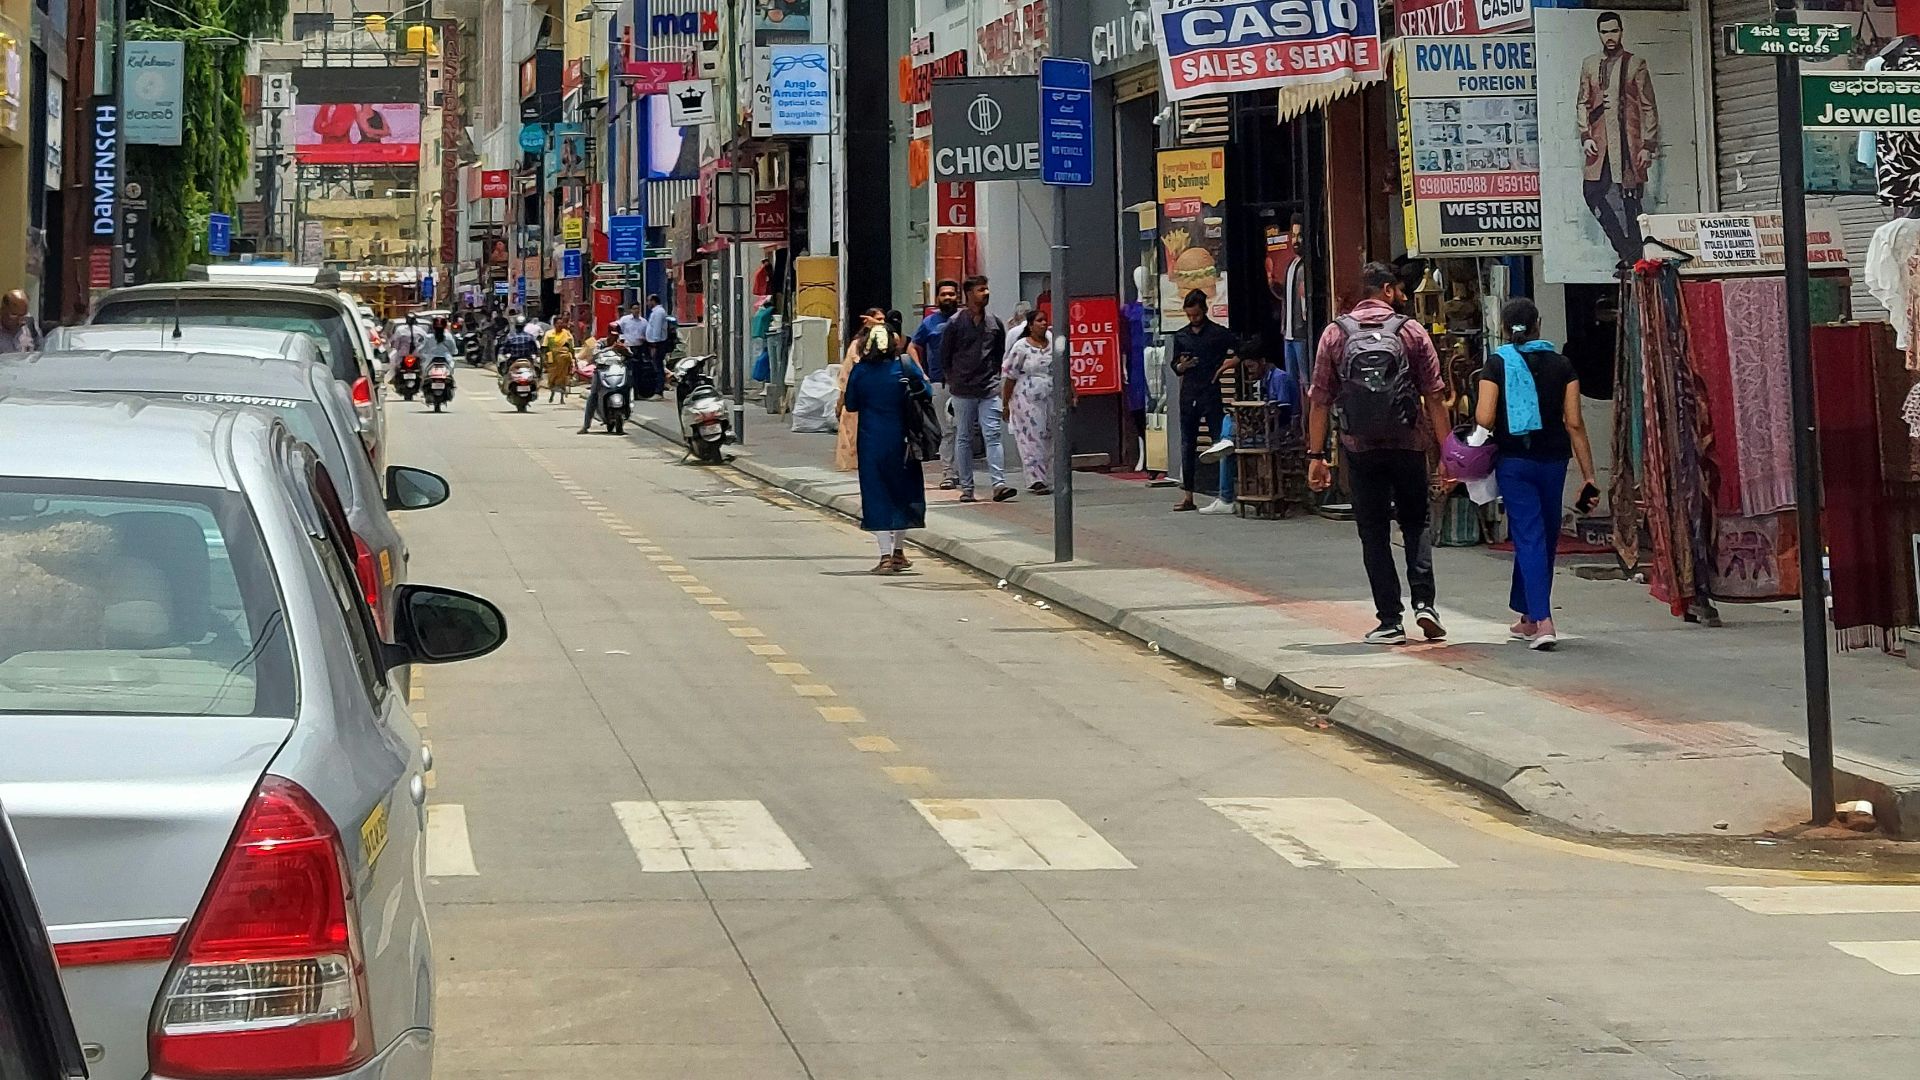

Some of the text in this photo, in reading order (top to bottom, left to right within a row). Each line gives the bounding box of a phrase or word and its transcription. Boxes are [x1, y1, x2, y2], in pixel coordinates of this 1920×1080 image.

[1400, 0, 1466, 36] SERVICE
[1482, 0, 1524, 20] CASIO
[652, 10, 718, 36] max
[1181, 0, 1358, 46] CASIO
[1761, 41, 1830, 53] 4th Cross
[1181, 39, 1369, 82] SALES & SERVIE
[1416, 43, 1477, 71] ROYAL
[784, 80, 817, 90] Anglo
[1458, 75, 1526, 91] FOREIGN
[773, 89, 828, 97] American
[778, 99, 808, 107] Optical
[1817, 103, 1920, 124] Jewelle
[935, 142, 1040, 176] CHIQUE
[1163, 173, 1210, 192] Big Savings!
[1419, 176, 1488, 195] 9980050988
[1497, 175, 1540, 193] 959150
[1446, 201, 1539, 216] WESTERN
[1479, 216, 1540, 230] UNION
[1700, 218, 1750, 229] KASHMERE
[124, 212, 139, 284] SILVE
[1440, 236, 1485, 247] MONEY
[1712, 249, 1756, 260] SOLD HERE
[1070, 322, 1113, 334] IQUE
[1070, 340, 1107, 356] LAT
